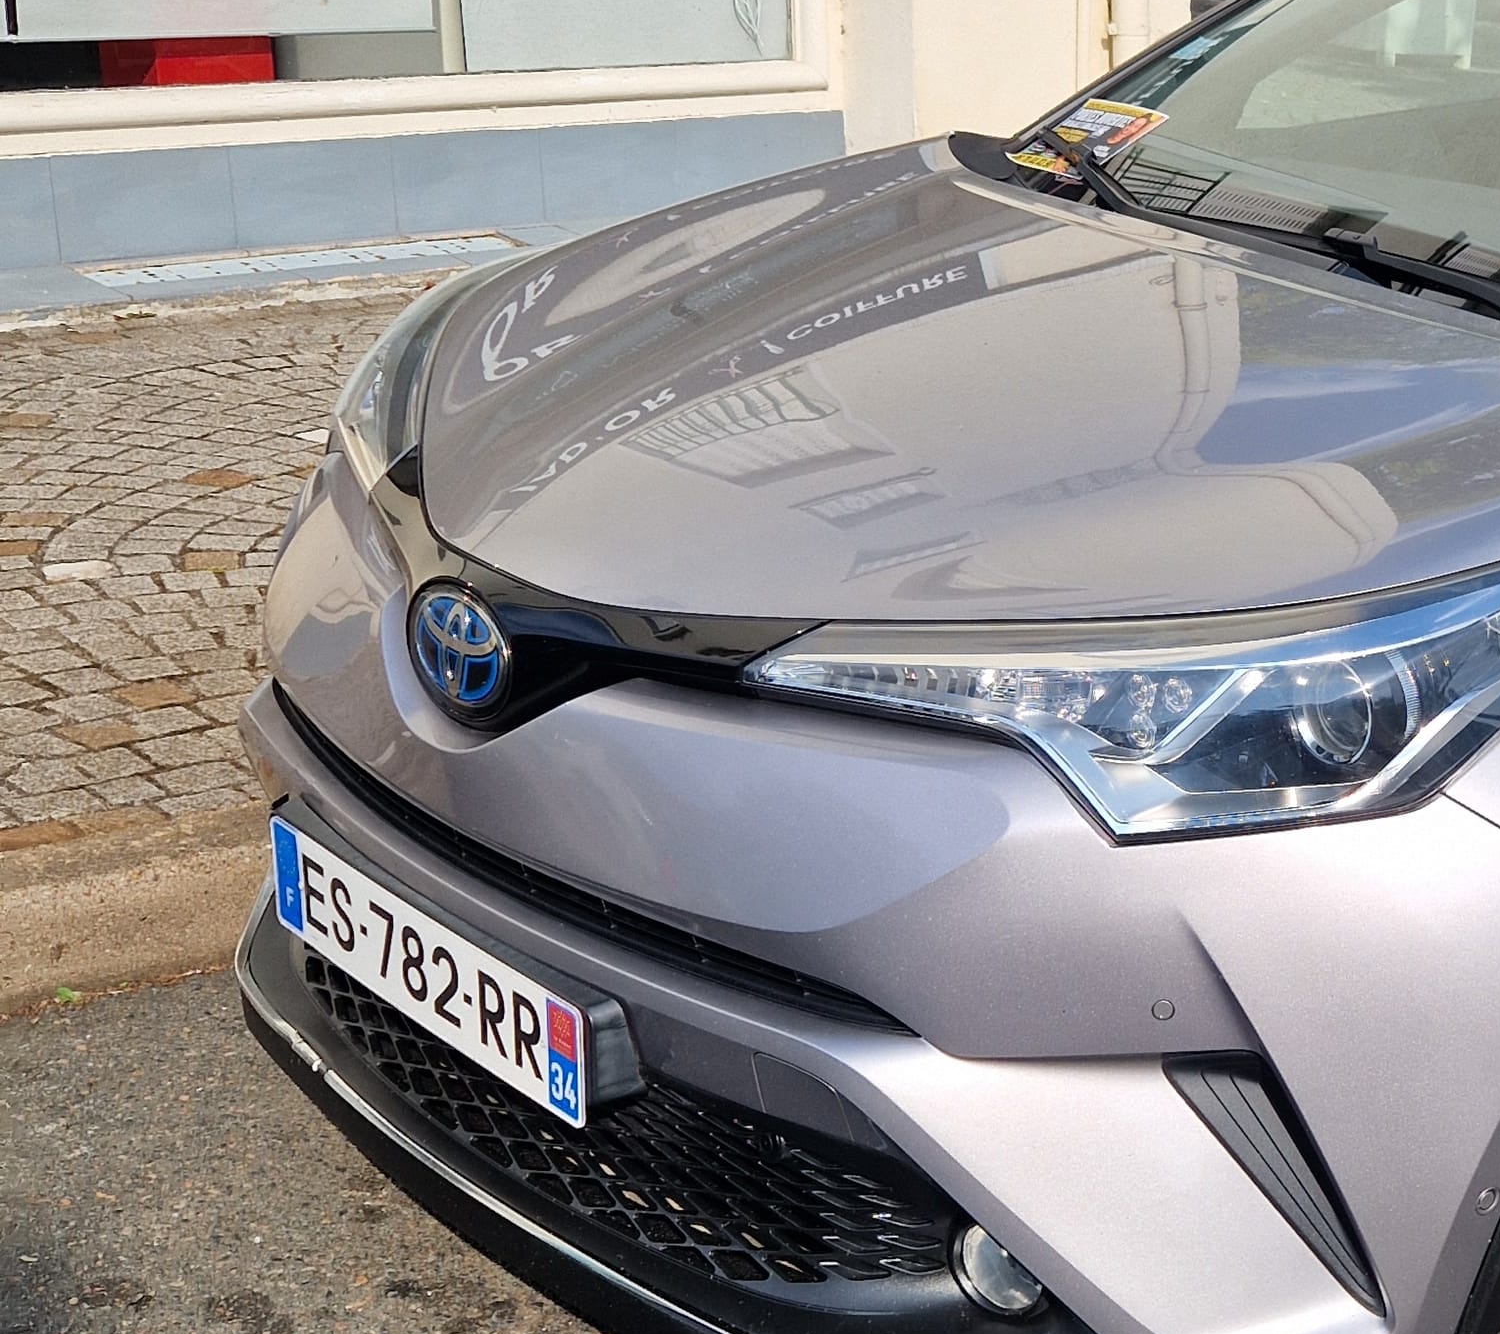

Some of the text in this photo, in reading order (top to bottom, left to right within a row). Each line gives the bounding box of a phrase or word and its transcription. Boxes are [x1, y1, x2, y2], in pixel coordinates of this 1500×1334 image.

[285, 852, 578, 1111] F ES-782-RR 34
